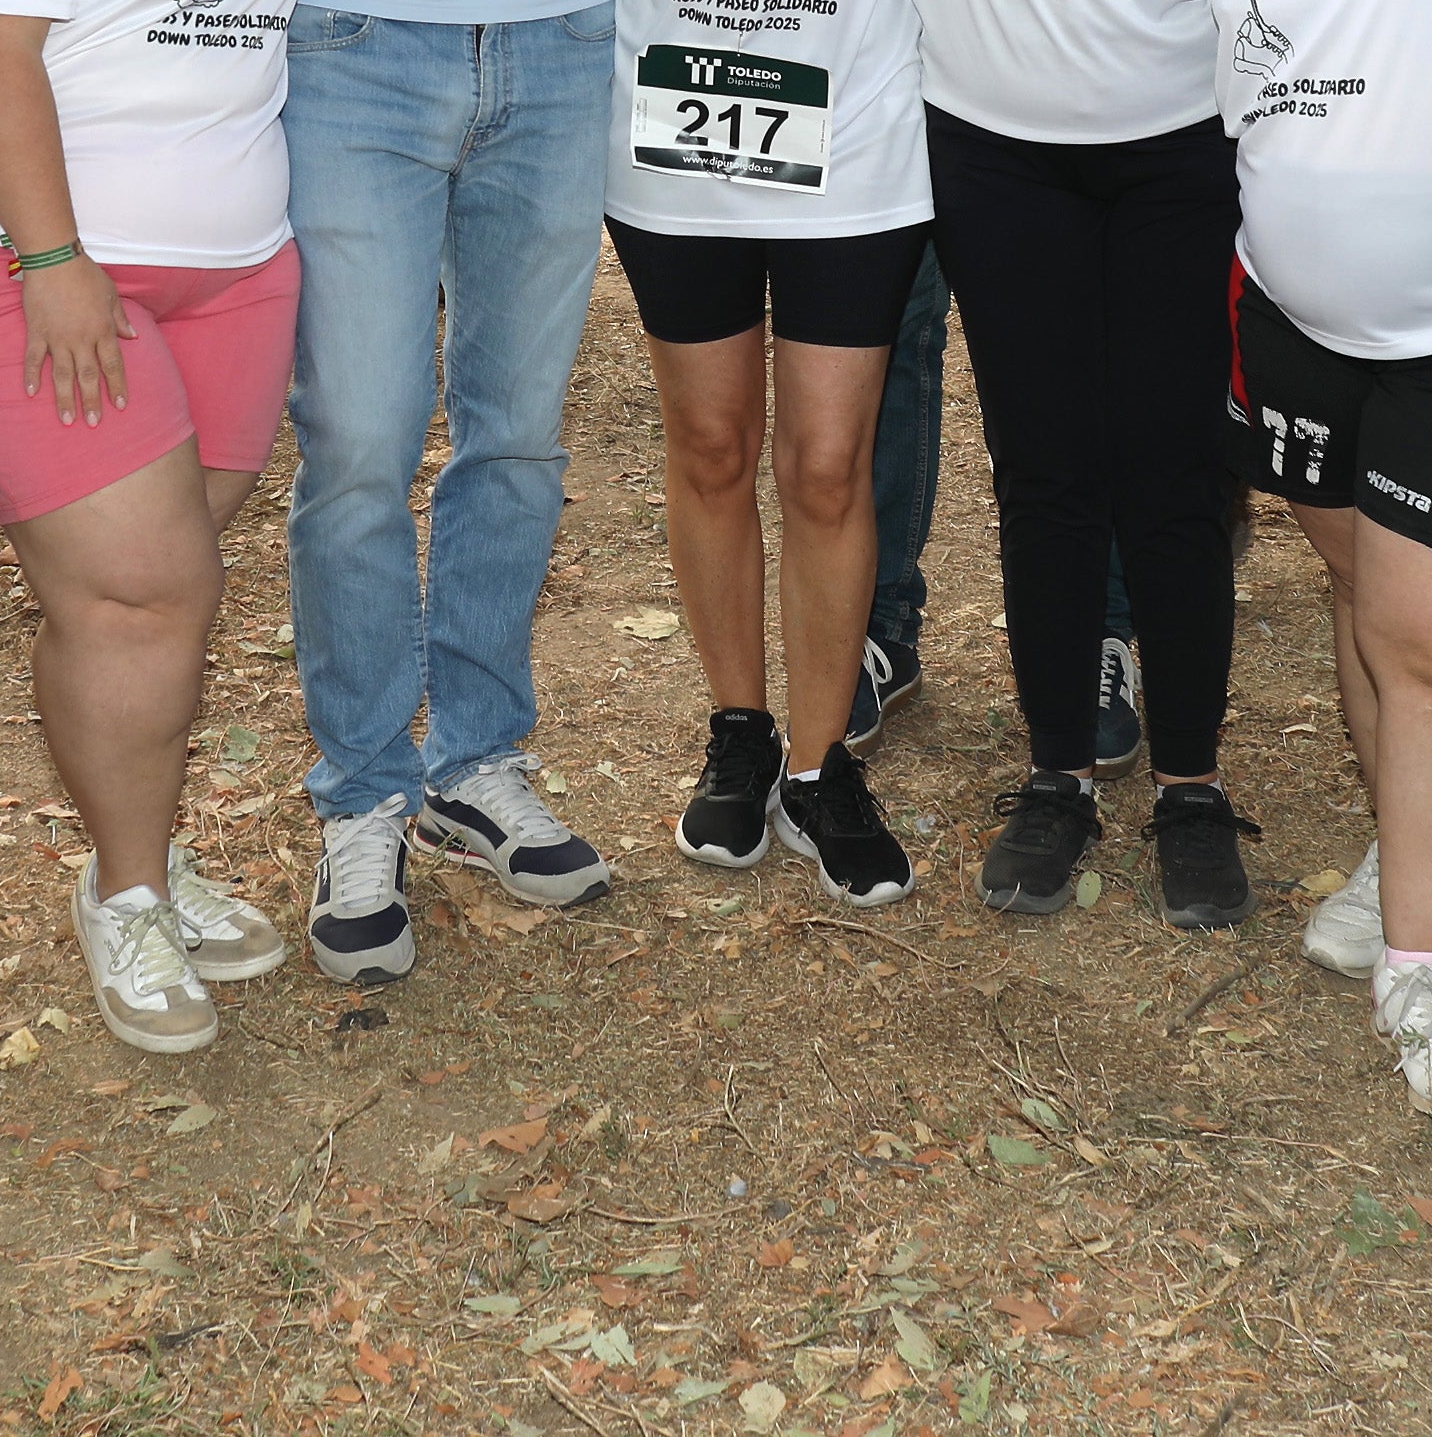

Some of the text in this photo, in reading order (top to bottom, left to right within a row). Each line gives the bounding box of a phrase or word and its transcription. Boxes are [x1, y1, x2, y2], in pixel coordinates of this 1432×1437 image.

[182, 11, 193, 27] Y
[678, 7, 802, 32] DOWN TOLEDO 2025
[147, 29, 191, 46] DOWN
[727, 65, 782, 82] TOLEDO
[727, 76, 781, 91] Diputación
[674, 98, 790, 155] 217
[683, 155, 774, 174] www.diputoledo.es
[724, 713, 748, 721] adidas
